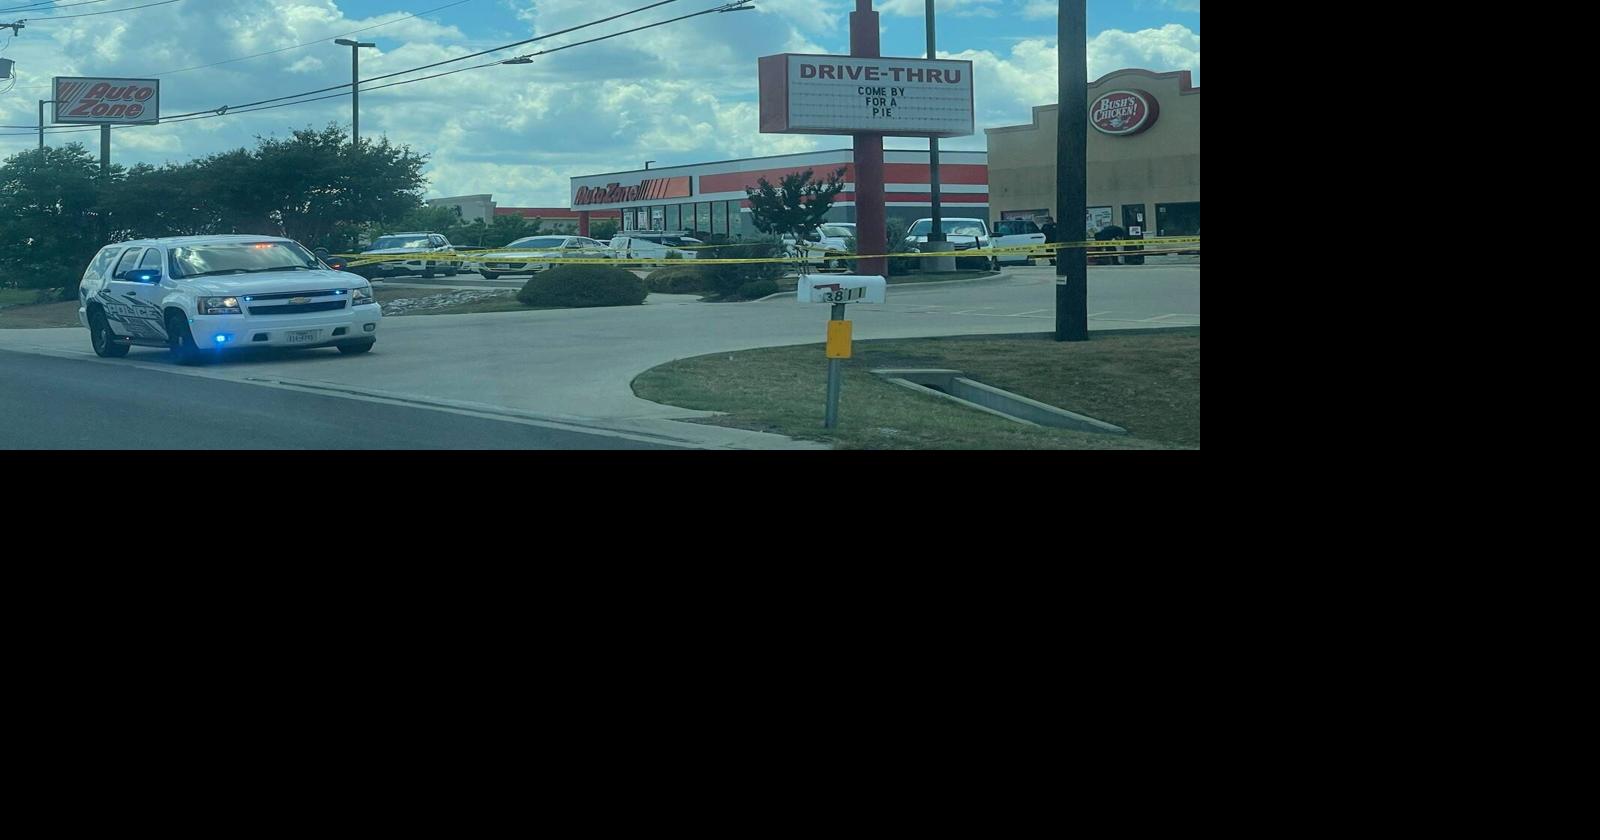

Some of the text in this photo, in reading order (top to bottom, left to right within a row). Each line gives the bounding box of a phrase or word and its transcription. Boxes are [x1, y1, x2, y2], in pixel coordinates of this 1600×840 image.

[800, 63, 961, 84] DRIVE-THRU
[84, 82, 154, 102] Auto
[858, 86, 905, 97] COME BY
[68, 99, 144, 118] Zone
[865, 97, 897, 107] FOR A
[872, 107, 892, 117] PIE
[574, 182, 641, 205] AutoZone
[826, 287, 863, 302] 3811
[107, 303, 160, 319] POLICE
